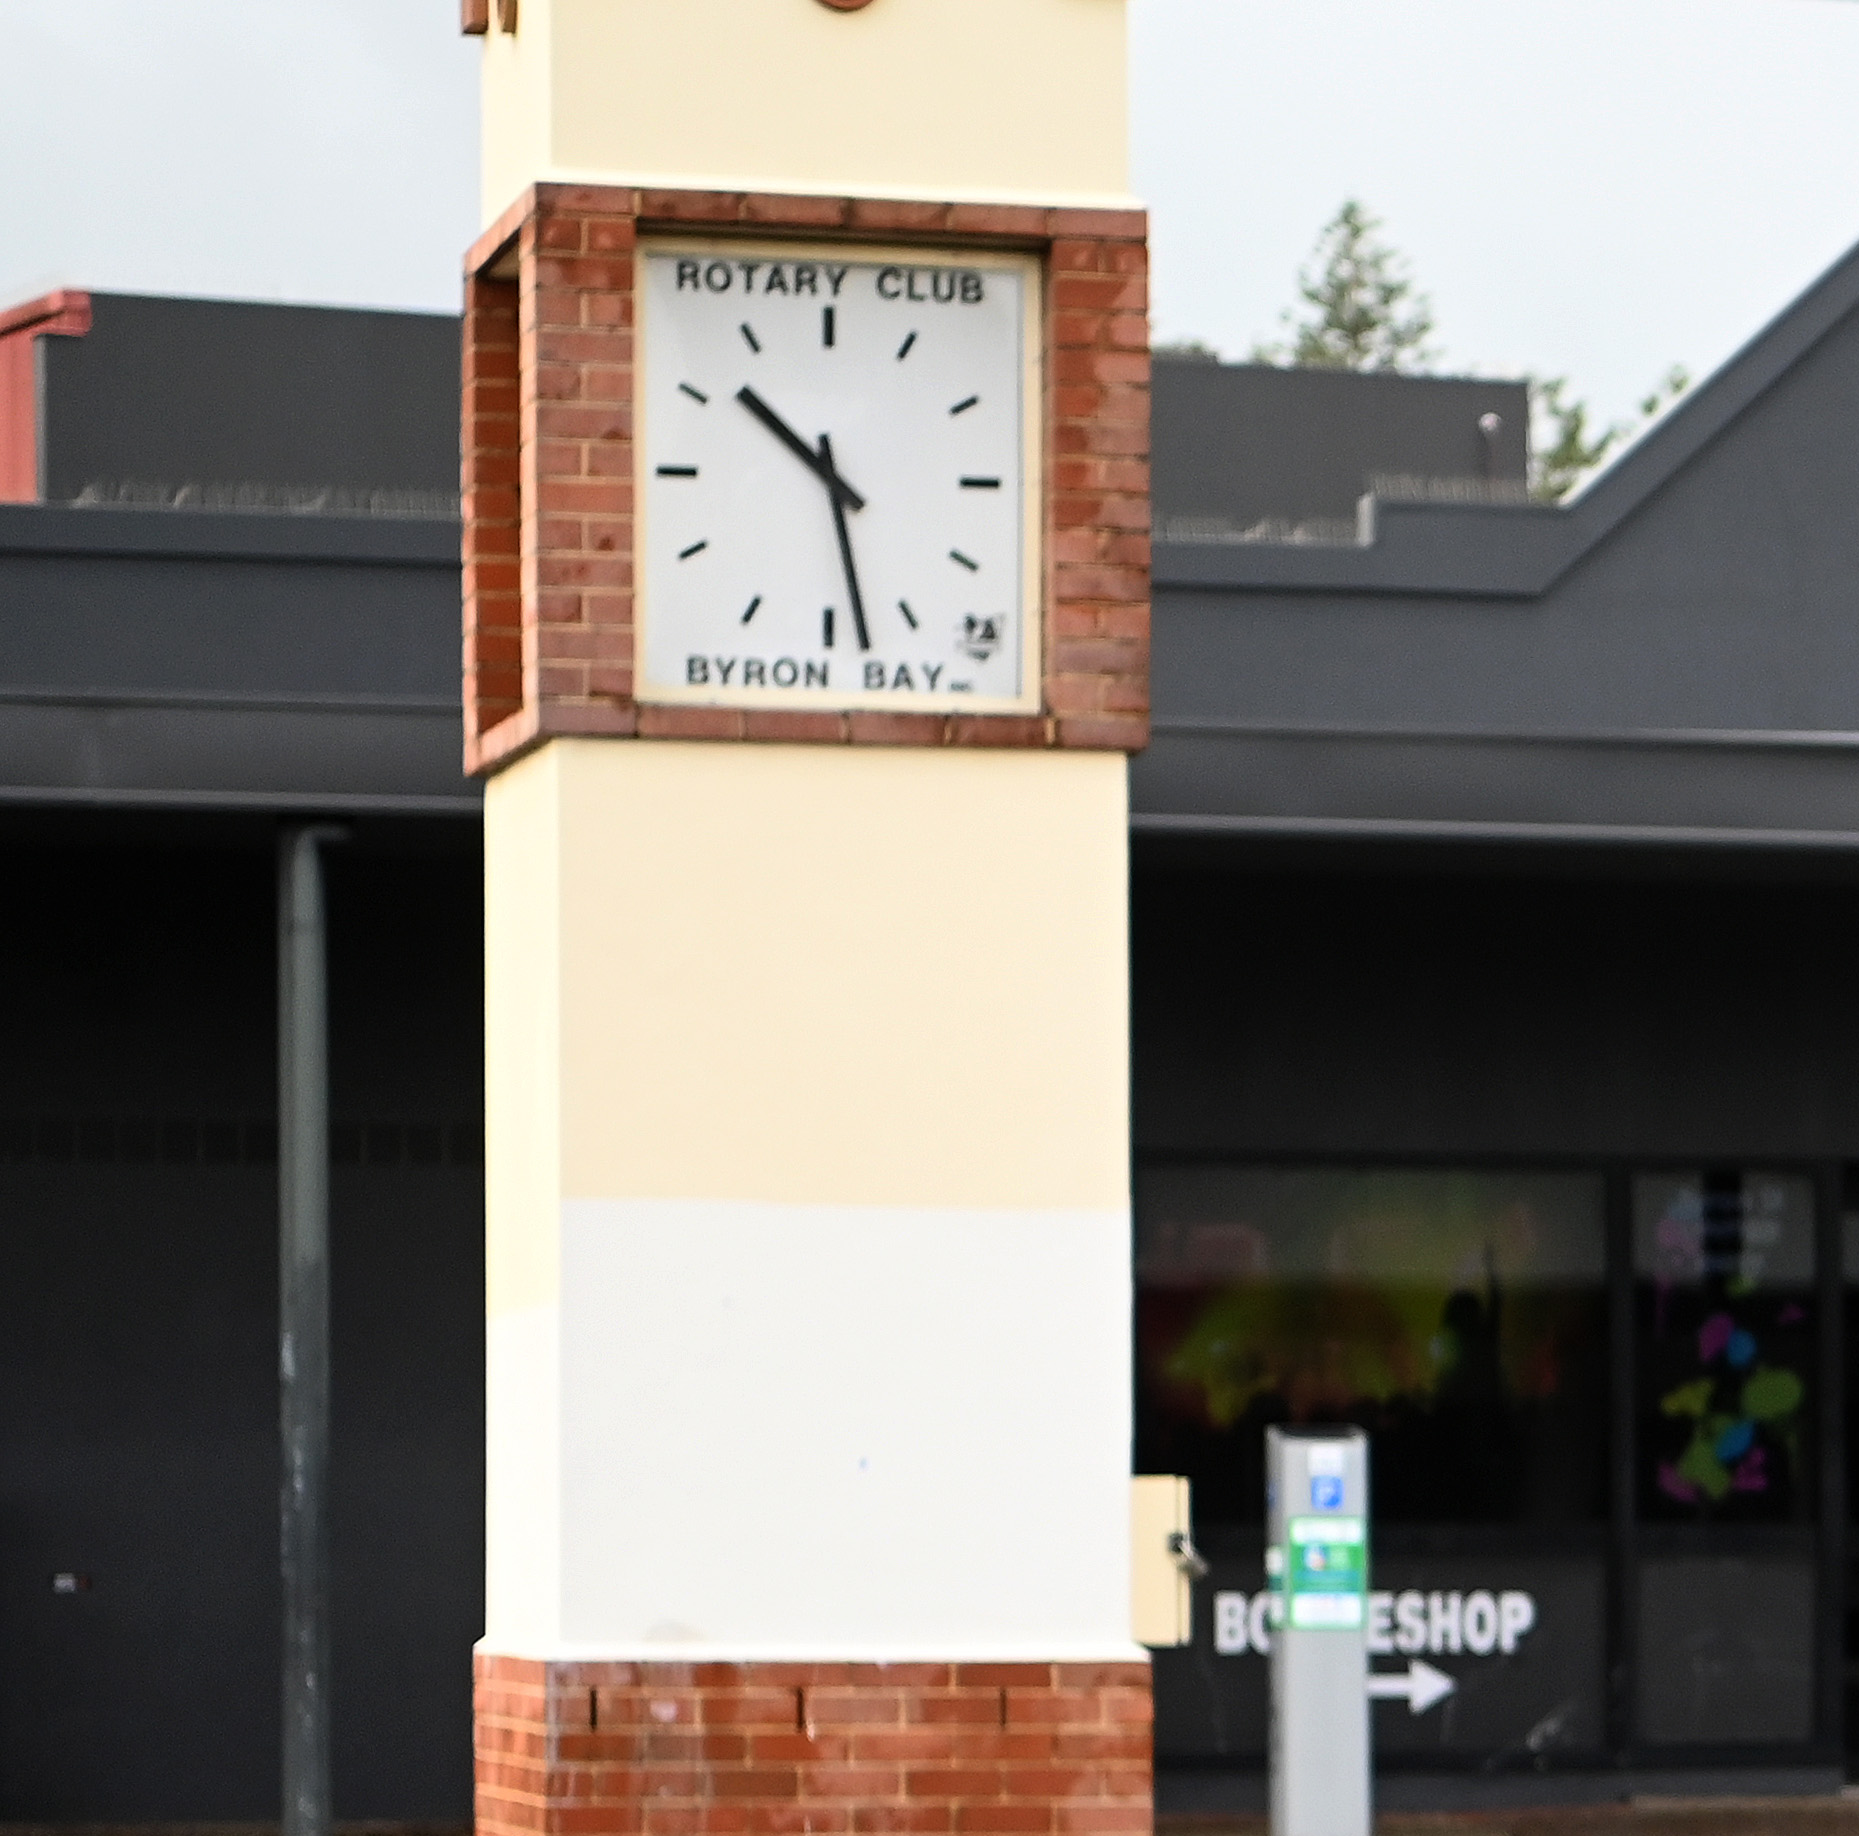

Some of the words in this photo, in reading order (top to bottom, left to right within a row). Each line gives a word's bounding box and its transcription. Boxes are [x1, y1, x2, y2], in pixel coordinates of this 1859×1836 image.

[676, 261, 848, 297] ROTARY
[876, 267, 984, 302] CLUB
[686, 657, 829, 689] BYRON
[864, 661, 945, 692] BAY
[1213, 1589, 1535, 1655] BOESHOP
